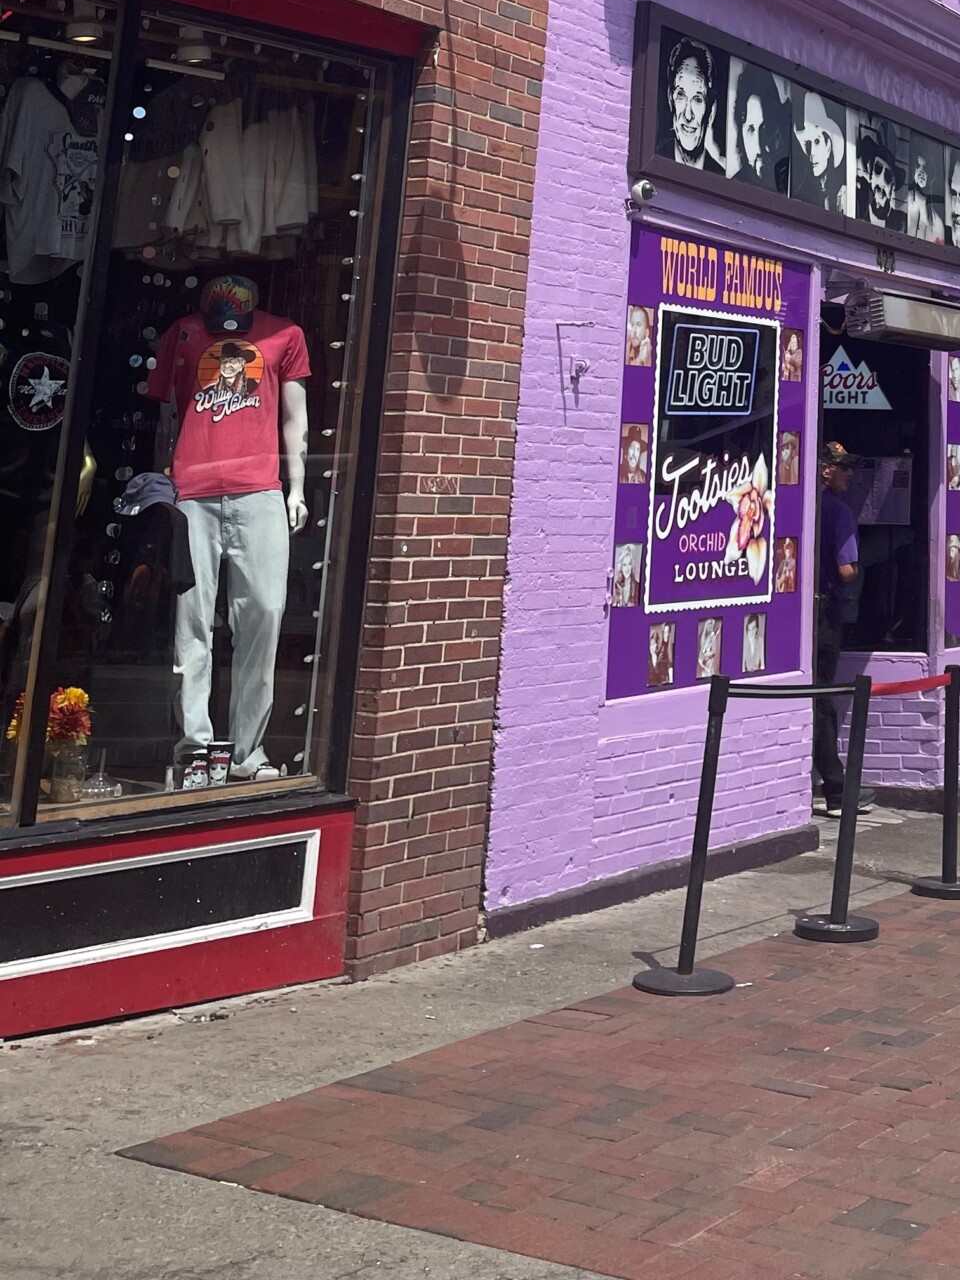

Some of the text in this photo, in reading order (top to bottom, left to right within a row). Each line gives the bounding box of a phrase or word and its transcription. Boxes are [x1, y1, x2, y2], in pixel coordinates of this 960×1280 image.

[661, 236, 783, 313] WORLD FAMOUS
[687, 333, 744, 370] BUD
[671, 370, 751, 407] LIGHT
[819, 363, 878, 391] Coors
[194, 389, 232, 413] Willie
[212, 393, 260, 422] Nelson
[655, 453, 753, 540] Tootsies
[679, 532, 726, 552] ORCHID
[674, 558, 749, 582] LOUNGE
